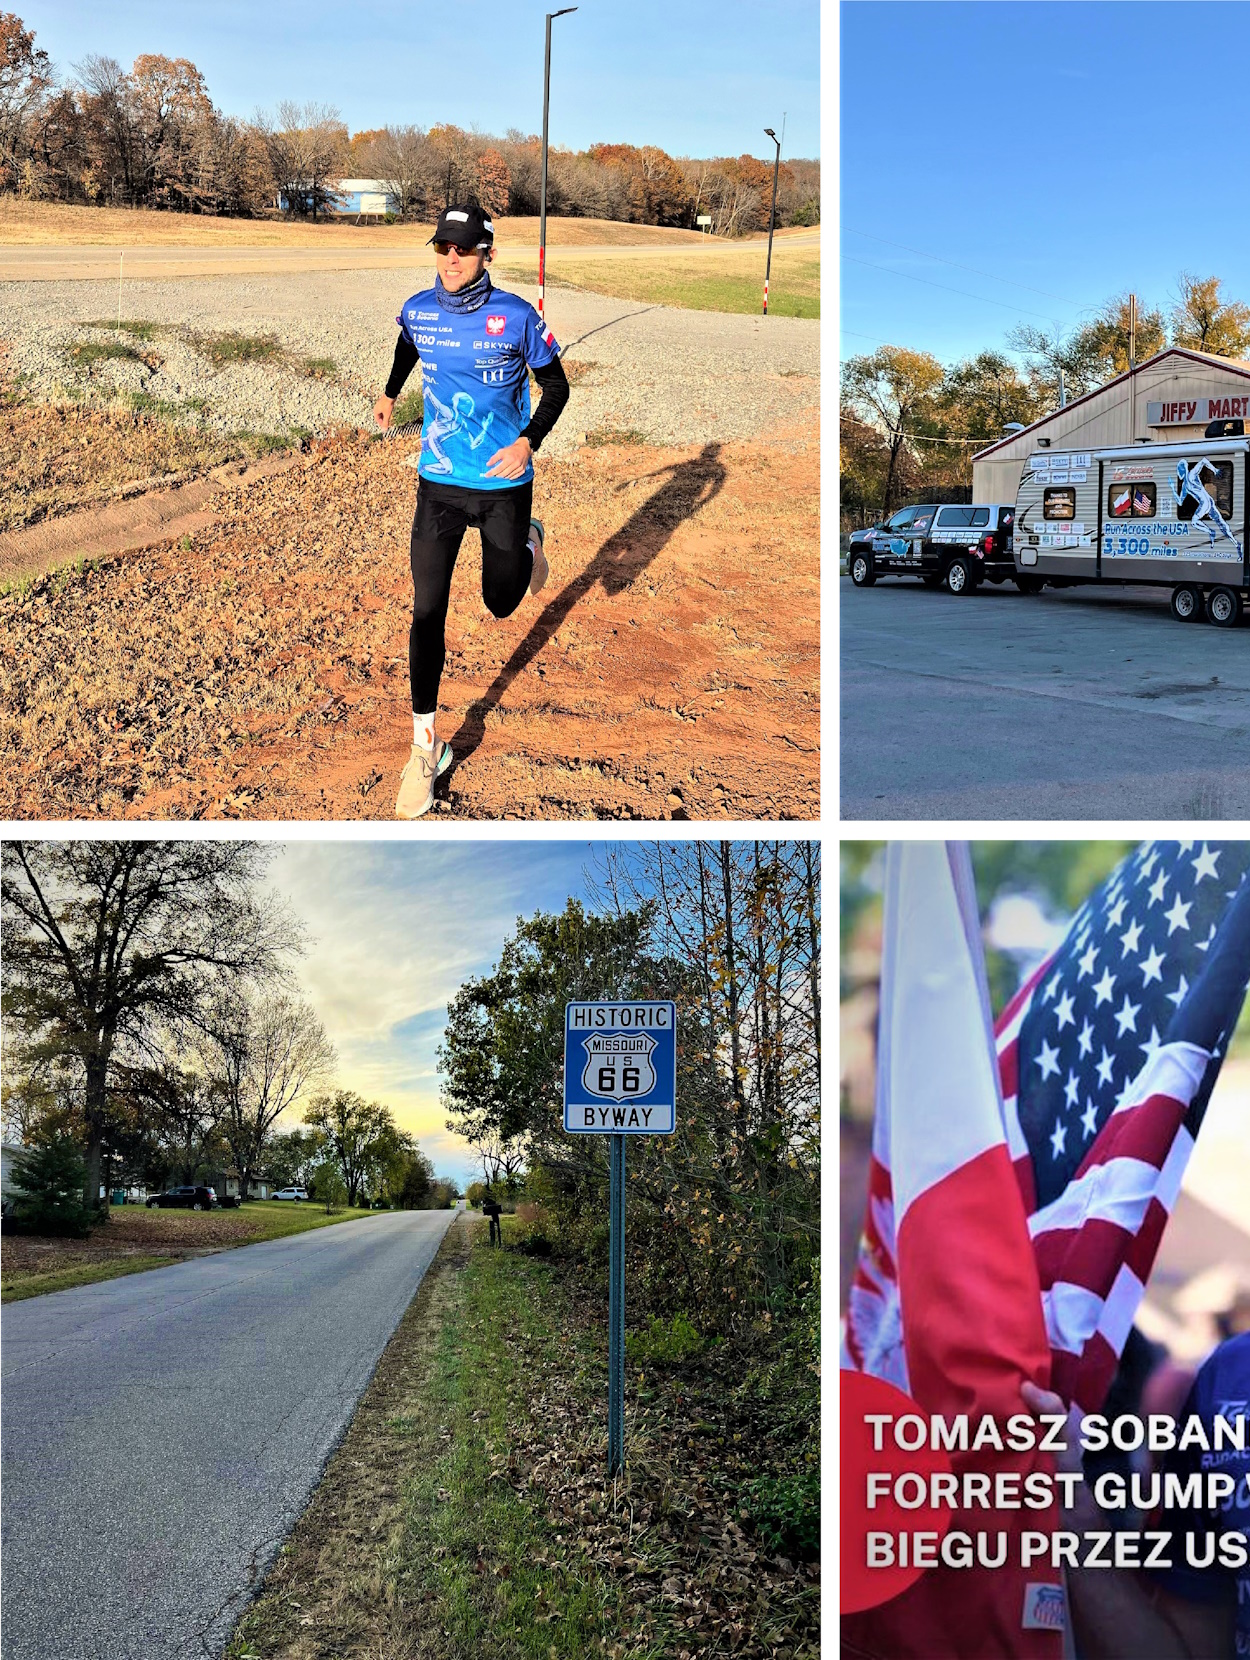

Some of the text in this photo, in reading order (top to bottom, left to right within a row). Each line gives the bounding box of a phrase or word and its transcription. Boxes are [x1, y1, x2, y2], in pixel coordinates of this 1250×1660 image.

[436, 339, 461, 347] miles
[1160, 397, 1250, 422] JIFFY MART
[1104, 523, 1190, 536] Run Across the USA
[1103, 538, 1150, 557] 3,300
[1150, 545, 1178, 557] miles
[574, 1007, 667, 1027] HISTORIC
[592, 1039, 648, 1051] MISSOURI
[598, 1067, 640, 1092] 66
[584, 1107, 653, 1127] BYWAY
